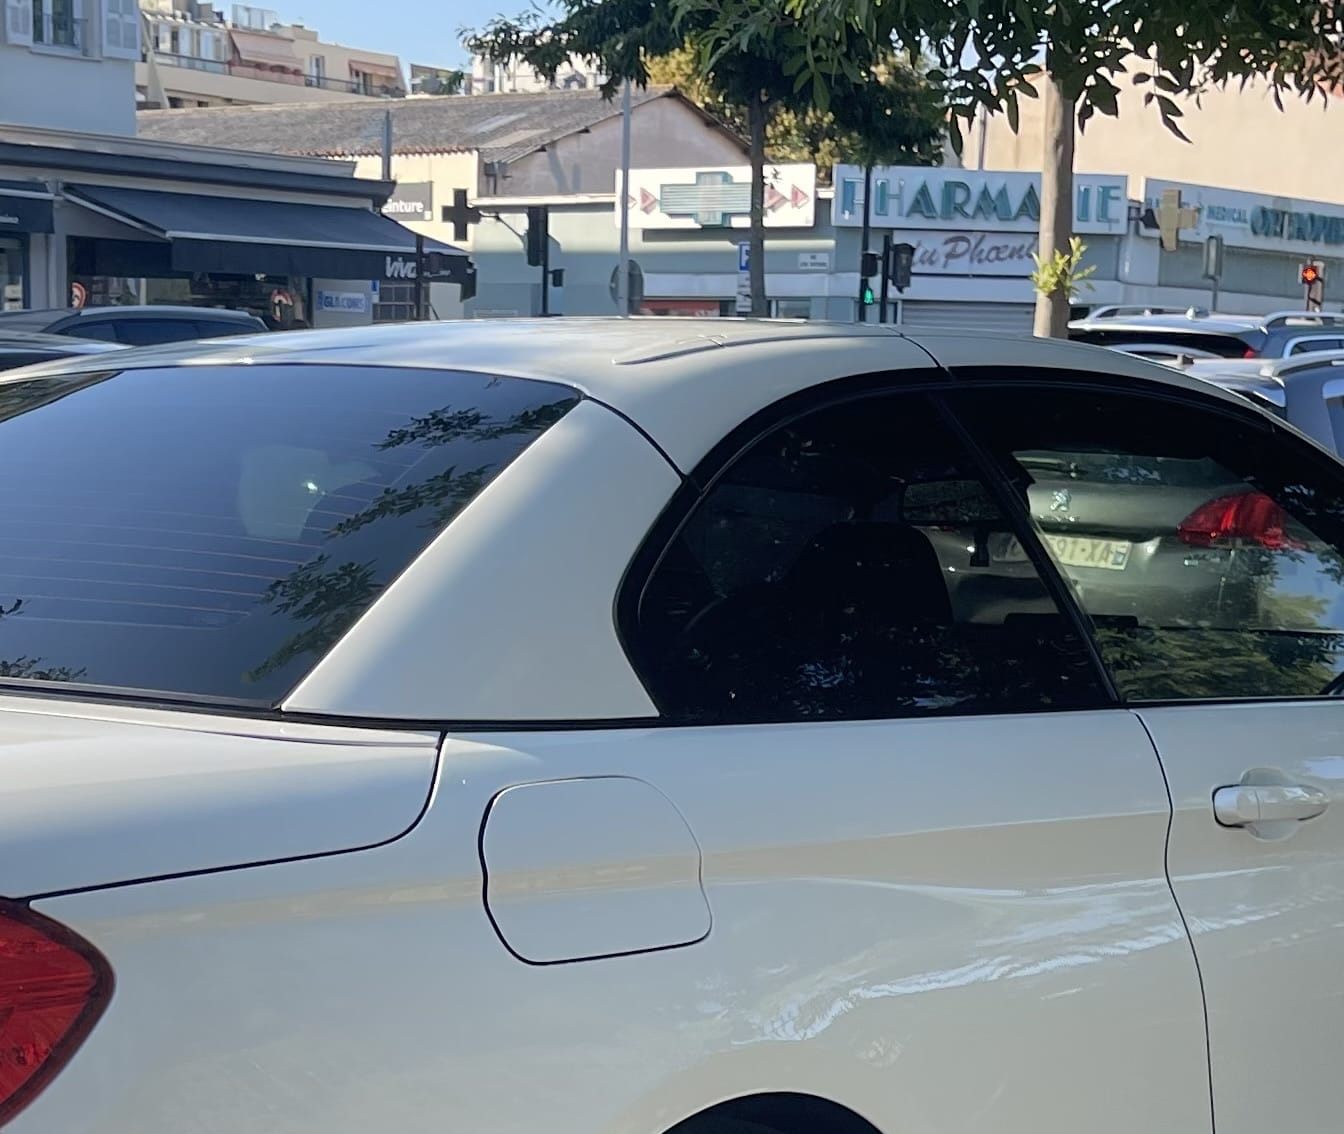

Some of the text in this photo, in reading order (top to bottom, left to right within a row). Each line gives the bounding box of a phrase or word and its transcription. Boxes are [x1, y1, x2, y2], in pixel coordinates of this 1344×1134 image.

[381, 199, 424, 213] einture
[842, 176, 1122, 223] PHARMAIE
[386, 256, 422, 279] Viva
